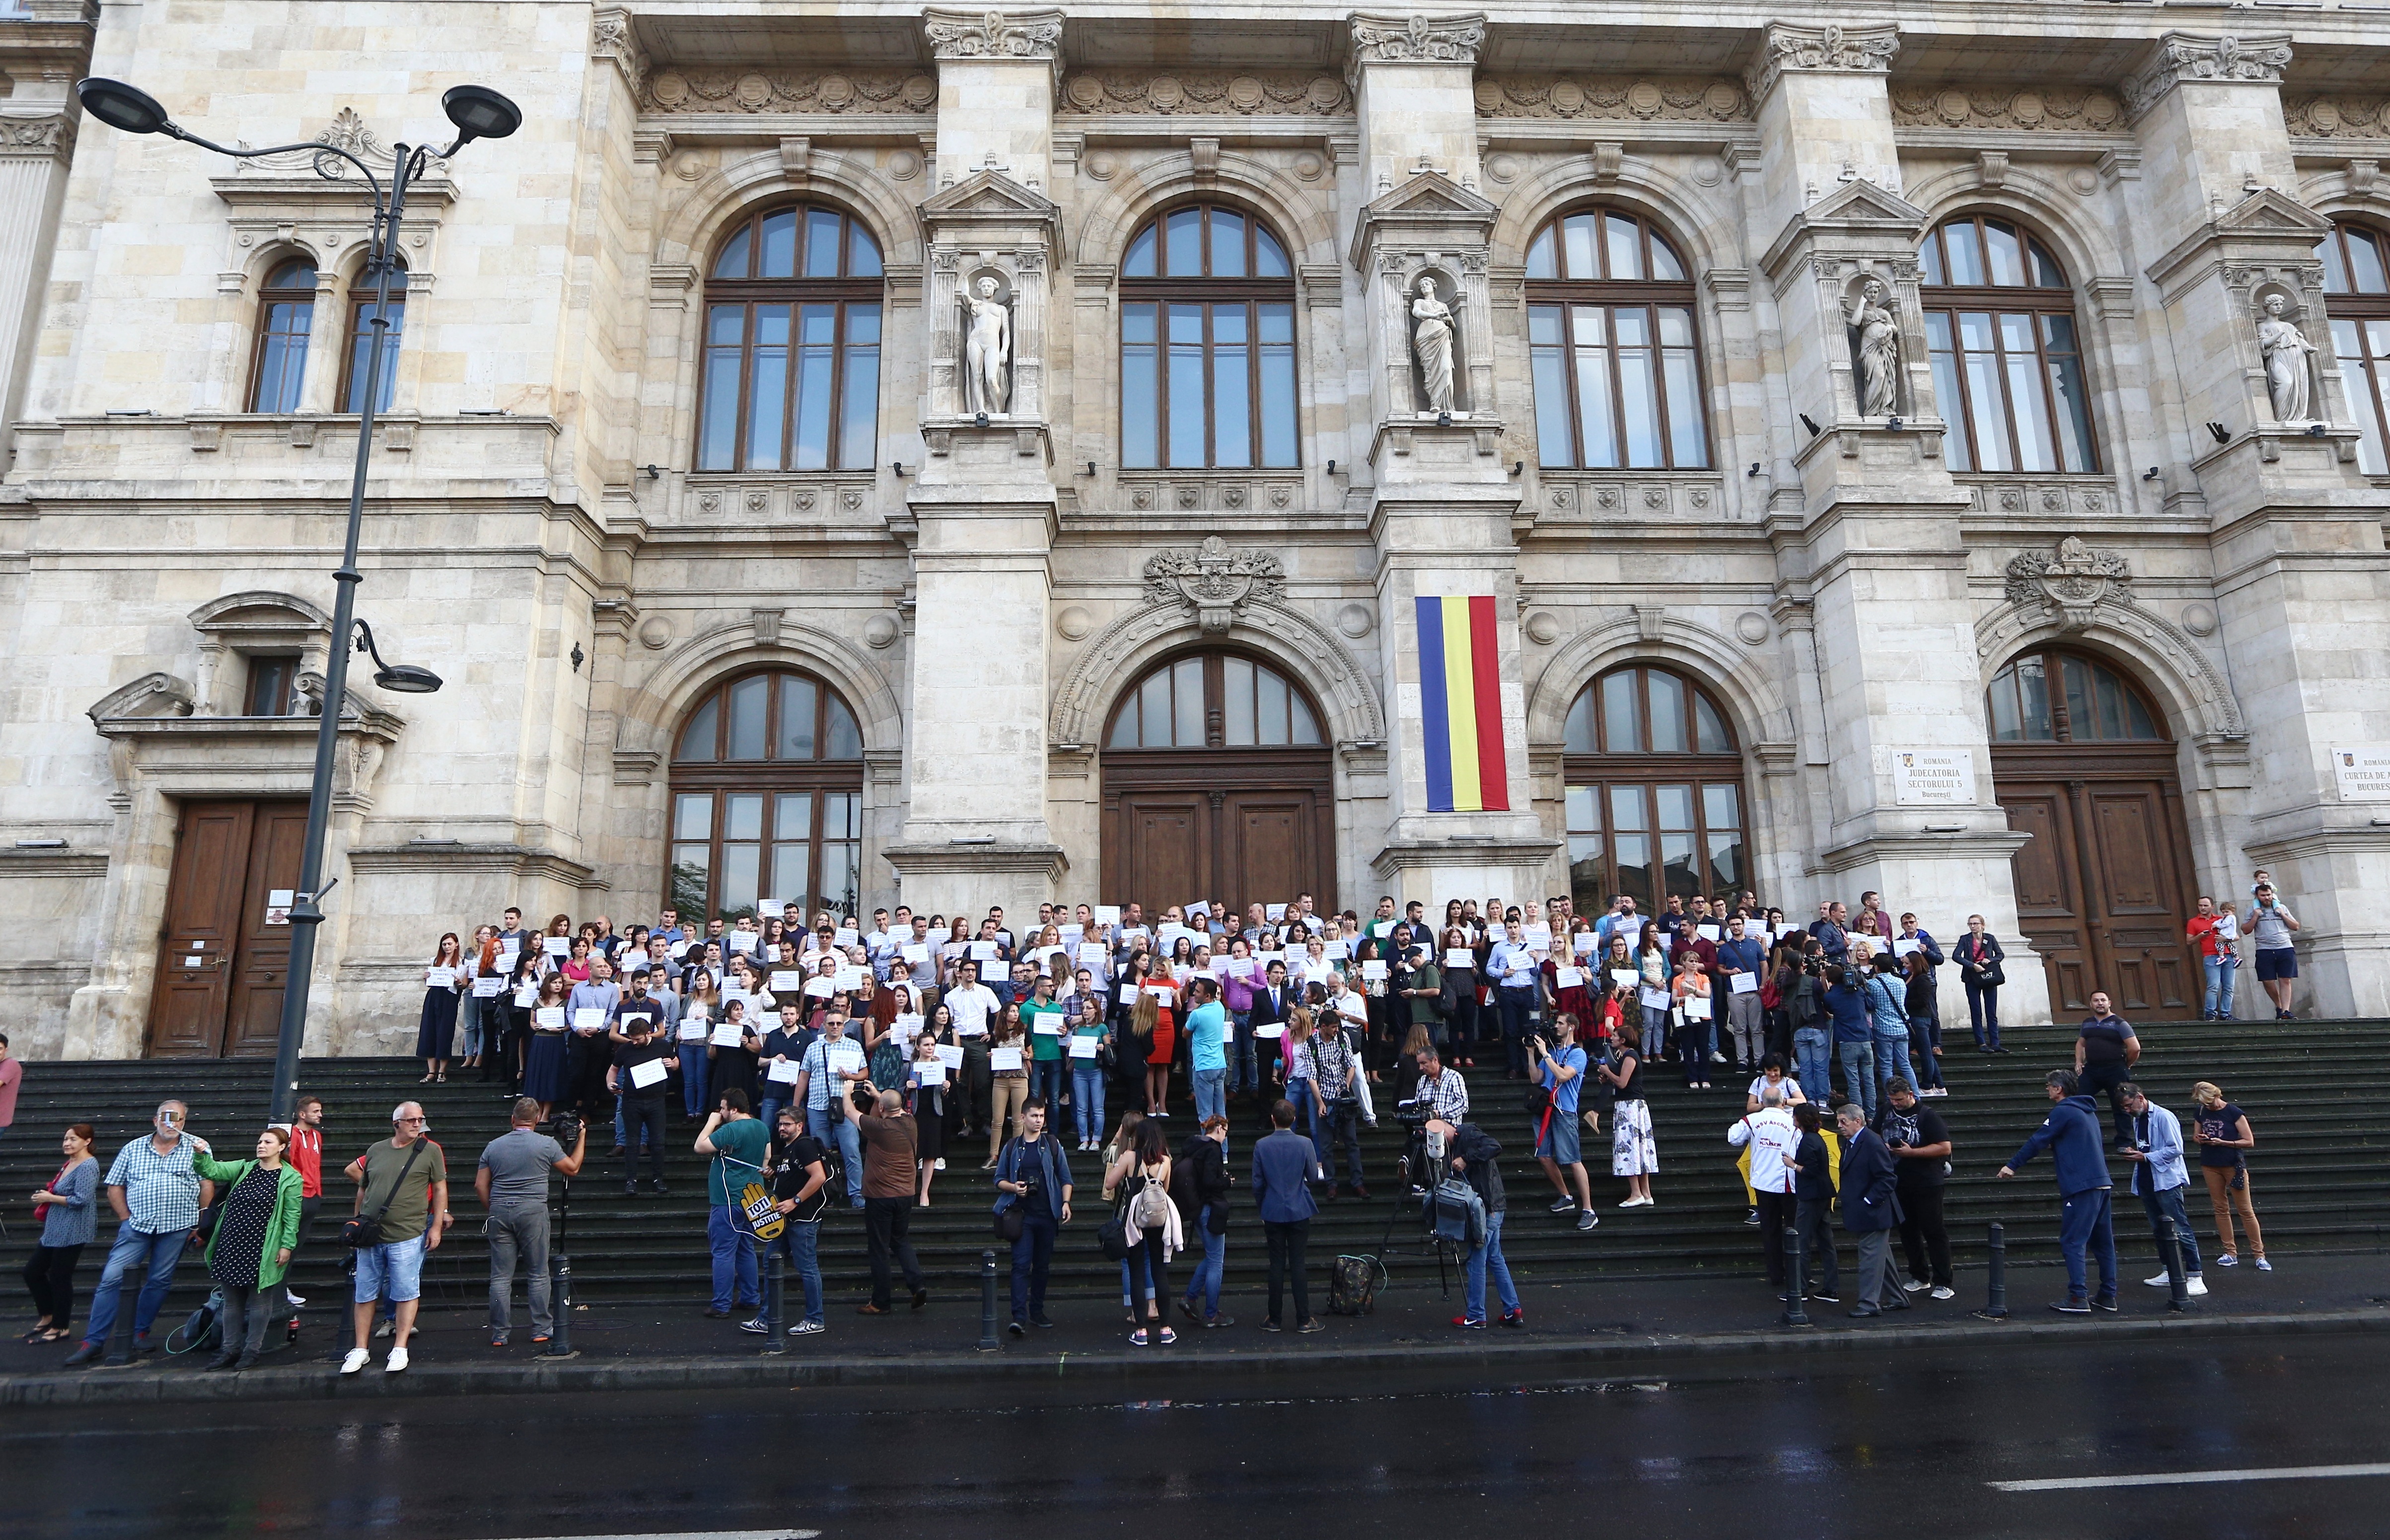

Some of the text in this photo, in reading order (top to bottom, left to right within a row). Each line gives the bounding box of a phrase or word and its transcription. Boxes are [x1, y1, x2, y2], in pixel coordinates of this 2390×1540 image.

[2344, 771, 2374, 780] CURTEA
[1755, 1120, 1790, 1132] WSV Aschau
